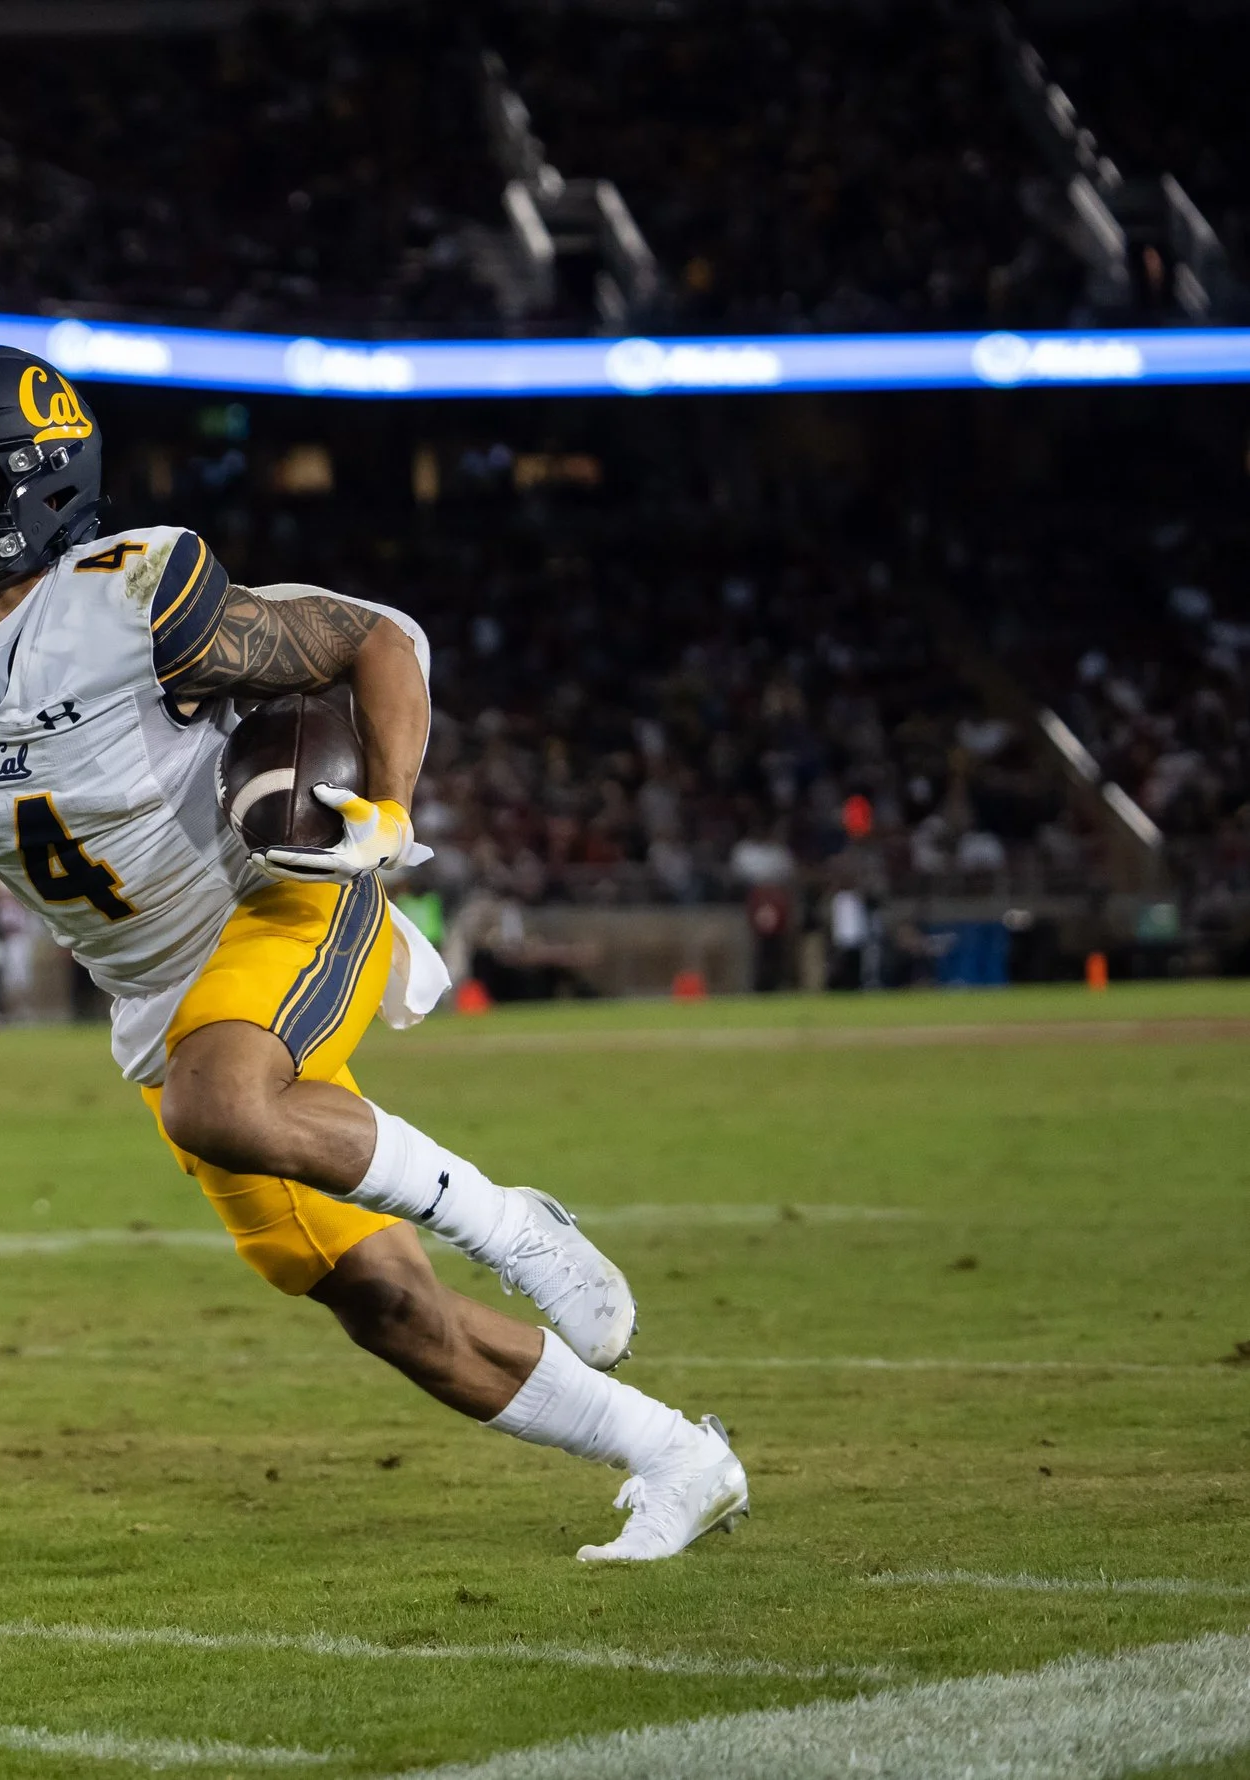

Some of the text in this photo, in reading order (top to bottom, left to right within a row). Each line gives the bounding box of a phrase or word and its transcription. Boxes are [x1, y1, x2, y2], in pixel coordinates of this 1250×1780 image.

[19, 366, 93, 445] Cal
[73, 541, 149, 573] 4
[14, 792, 140, 922] 4
